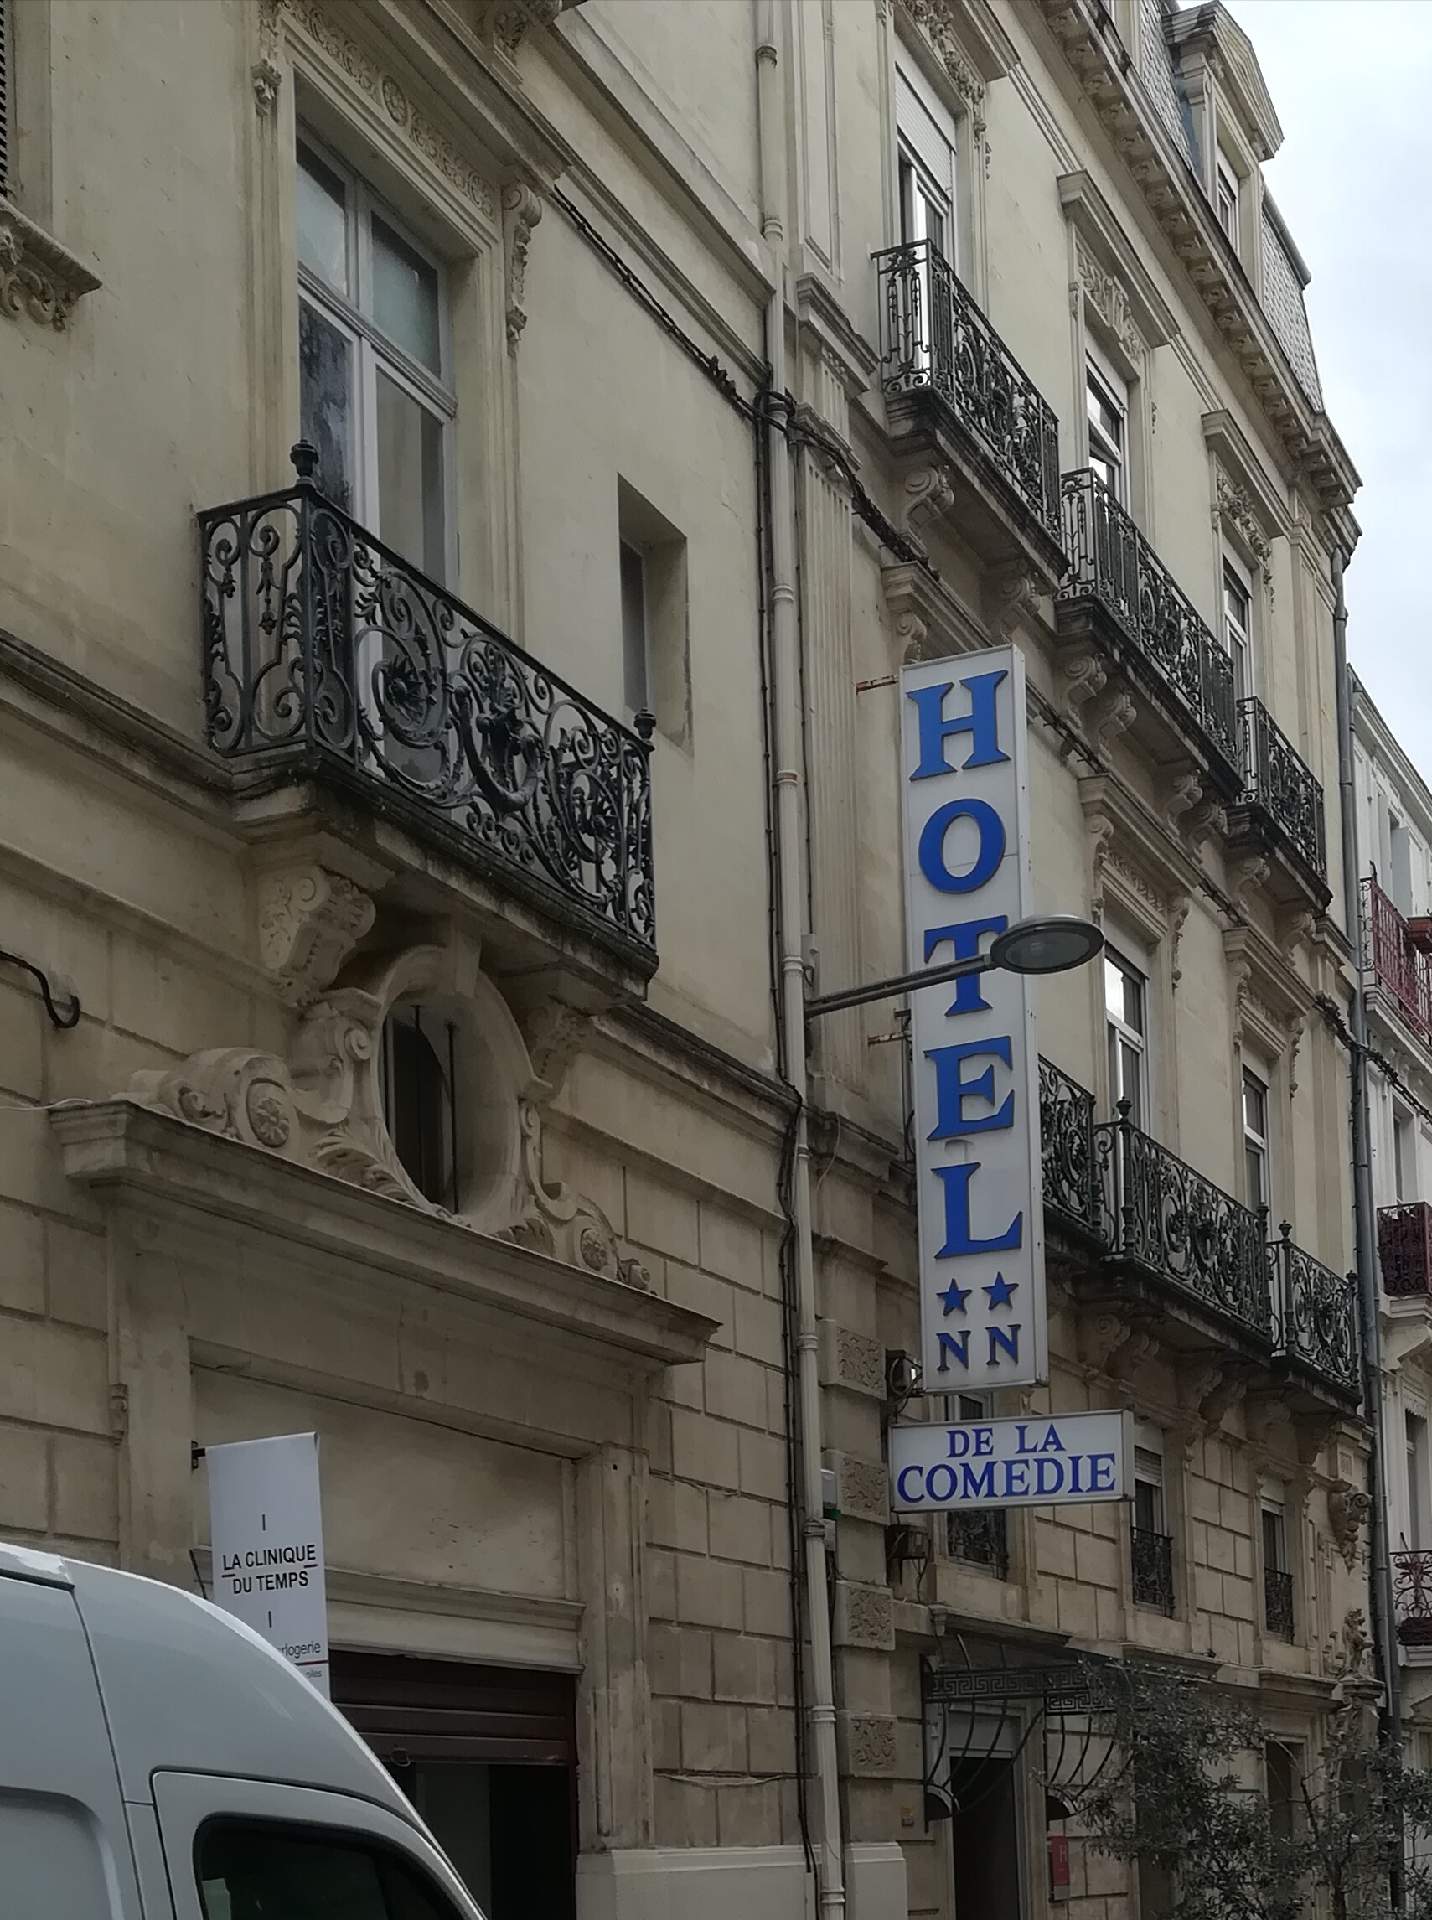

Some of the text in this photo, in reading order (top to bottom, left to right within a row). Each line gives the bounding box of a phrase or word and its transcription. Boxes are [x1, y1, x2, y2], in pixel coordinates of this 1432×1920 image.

[906, 669, 1023, 1259] HOTEL
[946, 1423, 1066, 1458] DE LA
[897, 1452, 1116, 1504] COMEDIE
[222, 1544, 317, 1571] LA CLINIQUE
[233, 1570, 309, 1595] DU TEMPS
[276, 1641, 321, 1659] rlogerie
